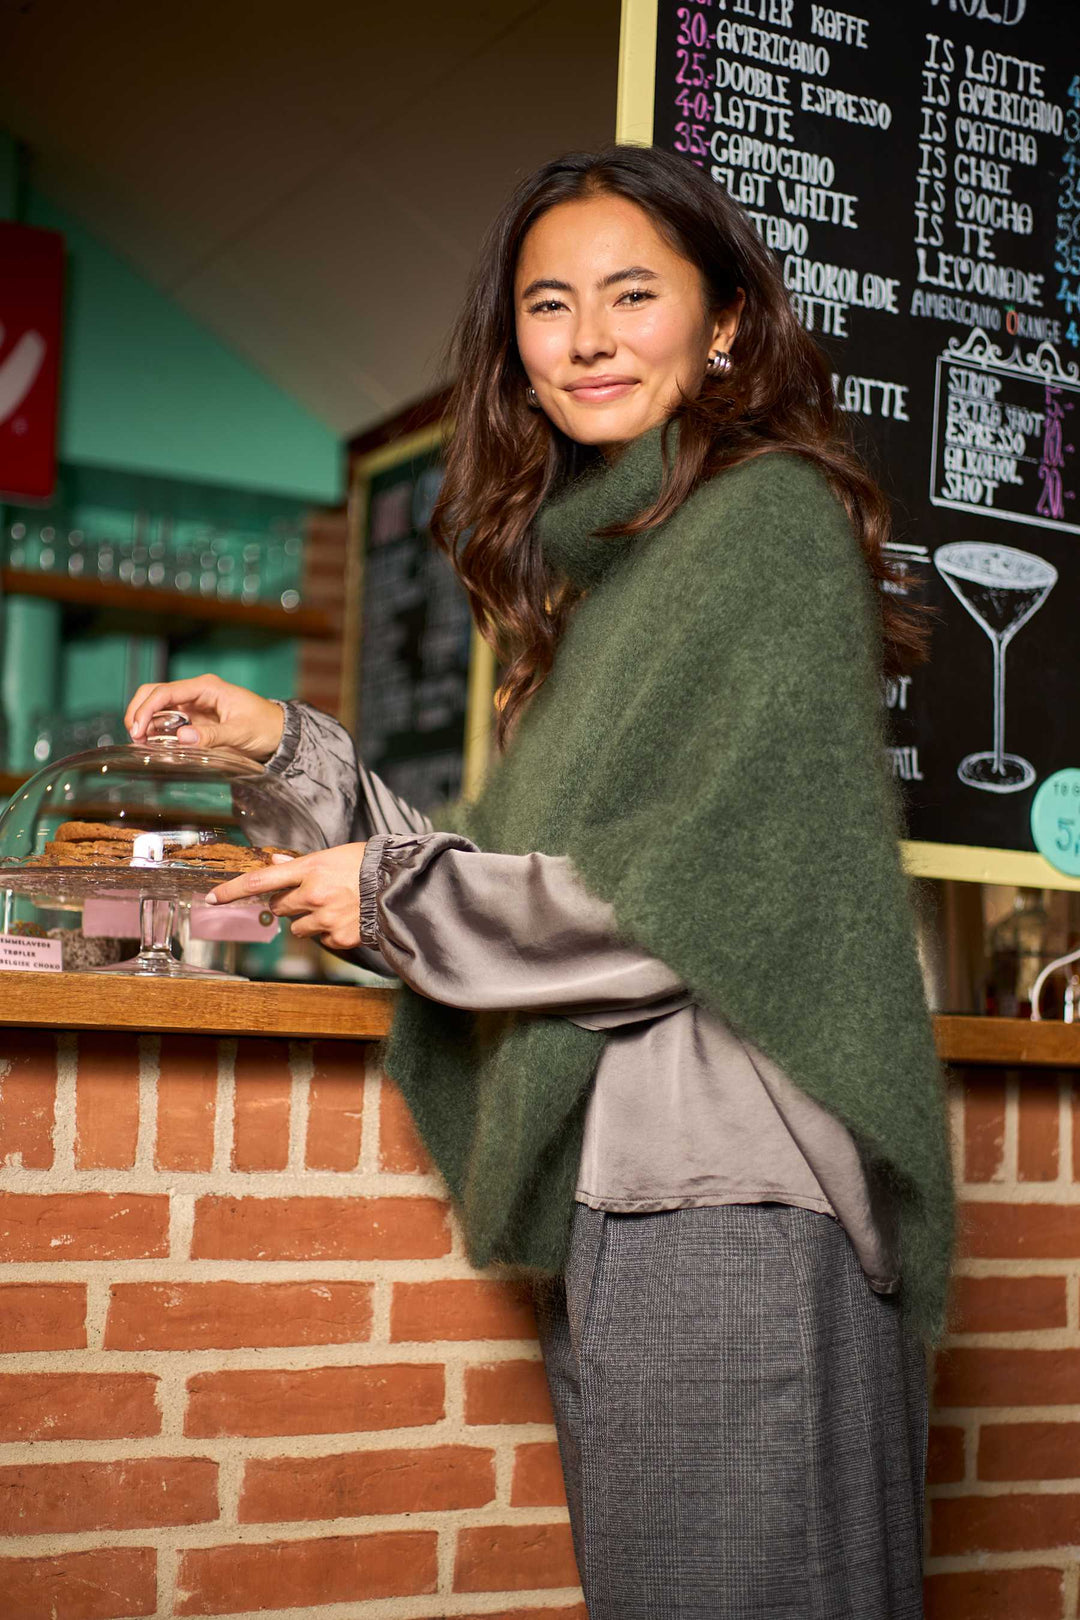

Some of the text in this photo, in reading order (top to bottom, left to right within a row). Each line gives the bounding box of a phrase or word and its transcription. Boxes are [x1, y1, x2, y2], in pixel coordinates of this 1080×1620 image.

[717, 19, 830, 77] AMERICANO
[811, 4, 869, 49] KAFFE
[925, 33, 954, 73] IS
[965, 45, 1046, 98] LATTE
[713, 92, 795, 142] LATTE
[801, 81, 892, 130] ESPRESSO
[921, 70, 950, 107] IS
[958, 80, 1064, 136] AMERICANO
[919, 107, 947, 143] IS
[955, 117, 1037, 166] MATCHA
[918, 143, 947, 179] IS
[954, 154, 1013, 195] CHAI
[711, 165, 859, 229] FLAT WHITE
[914, 176, 946, 213] IS
[955, 186, 1033, 234] MOCHA
[747, 210, 809, 256] TADO
[914, 210, 943, 247] IS
[956, 220, 996, 260] TE
[783, 254, 900, 315] CHOKOLADE
[917, 248, 1045, 308] LEMONADE
[790, 292, 849, 338] ATTE
[911, 289, 1001, 331] AMERICANO
[1006, 308, 1061, 345] ORANGE
[832, 373, 909, 422] LATTE
[949, 396, 1002, 428] EXTRA
[946, 415, 1027, 456] ESPRESSO
[941, 471, 999, 506] SHOT
[945, 446, 1024, 486] ALKOHOL
